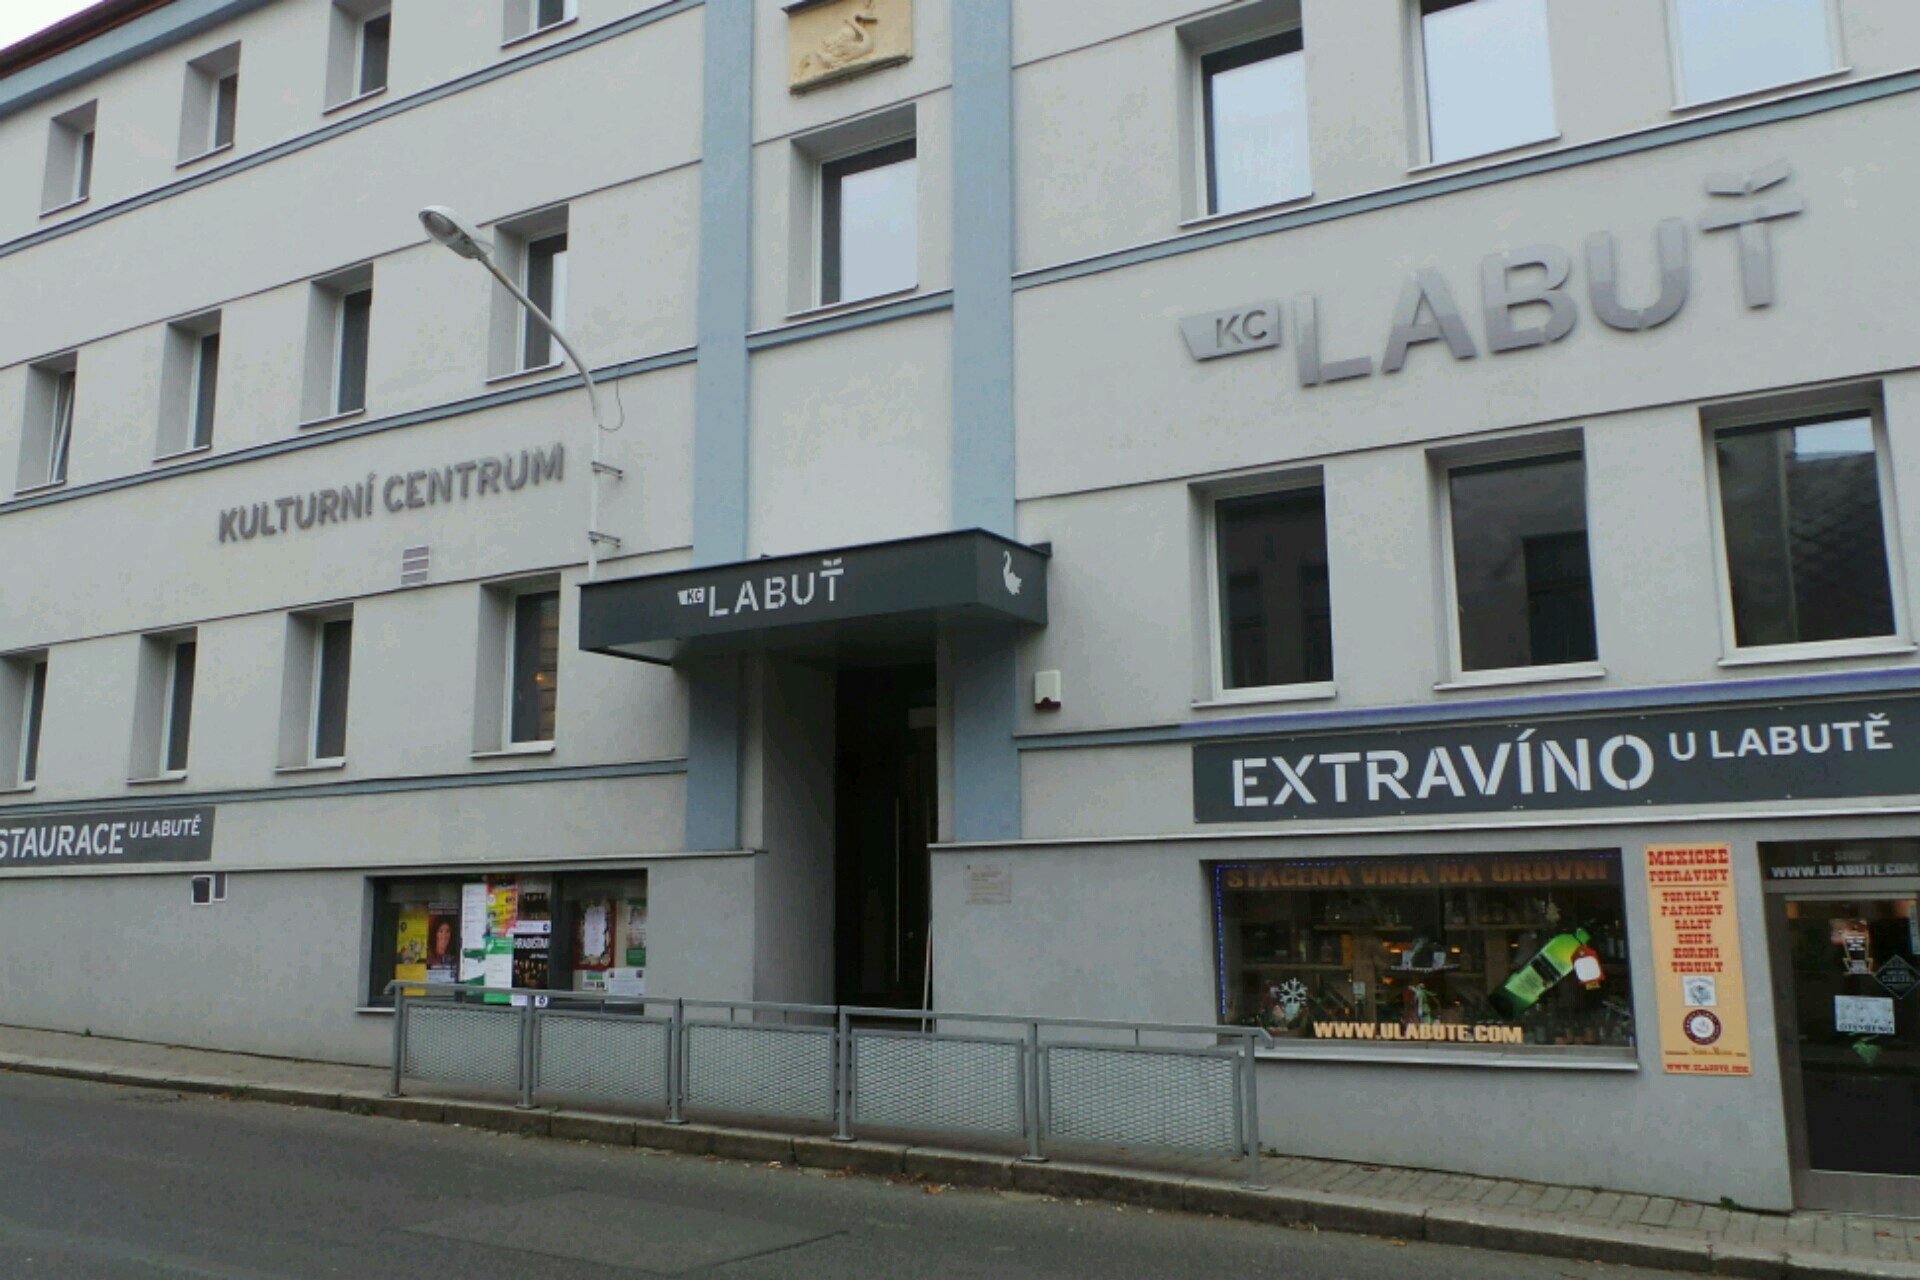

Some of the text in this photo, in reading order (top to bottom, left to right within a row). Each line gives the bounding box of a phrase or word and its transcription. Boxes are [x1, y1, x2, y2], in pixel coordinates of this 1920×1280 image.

[1215, 158, 1804, 388] KC LABUŤ
[218, 442, 566, 544] KULTURNÍ CENTRUM
[708, 557, 845, 617] LABUŤ
[1232, 712, 1894, 808] EXTRAVÍNO U LABUTĚ
[129, 821, 140, 838] U
[142, 814, 201, 839] LABUTĚ
[1438, 864, 1483, 884] NA
[1313, 1021, 1525, 1044] WWW.ULABUTE.COM
